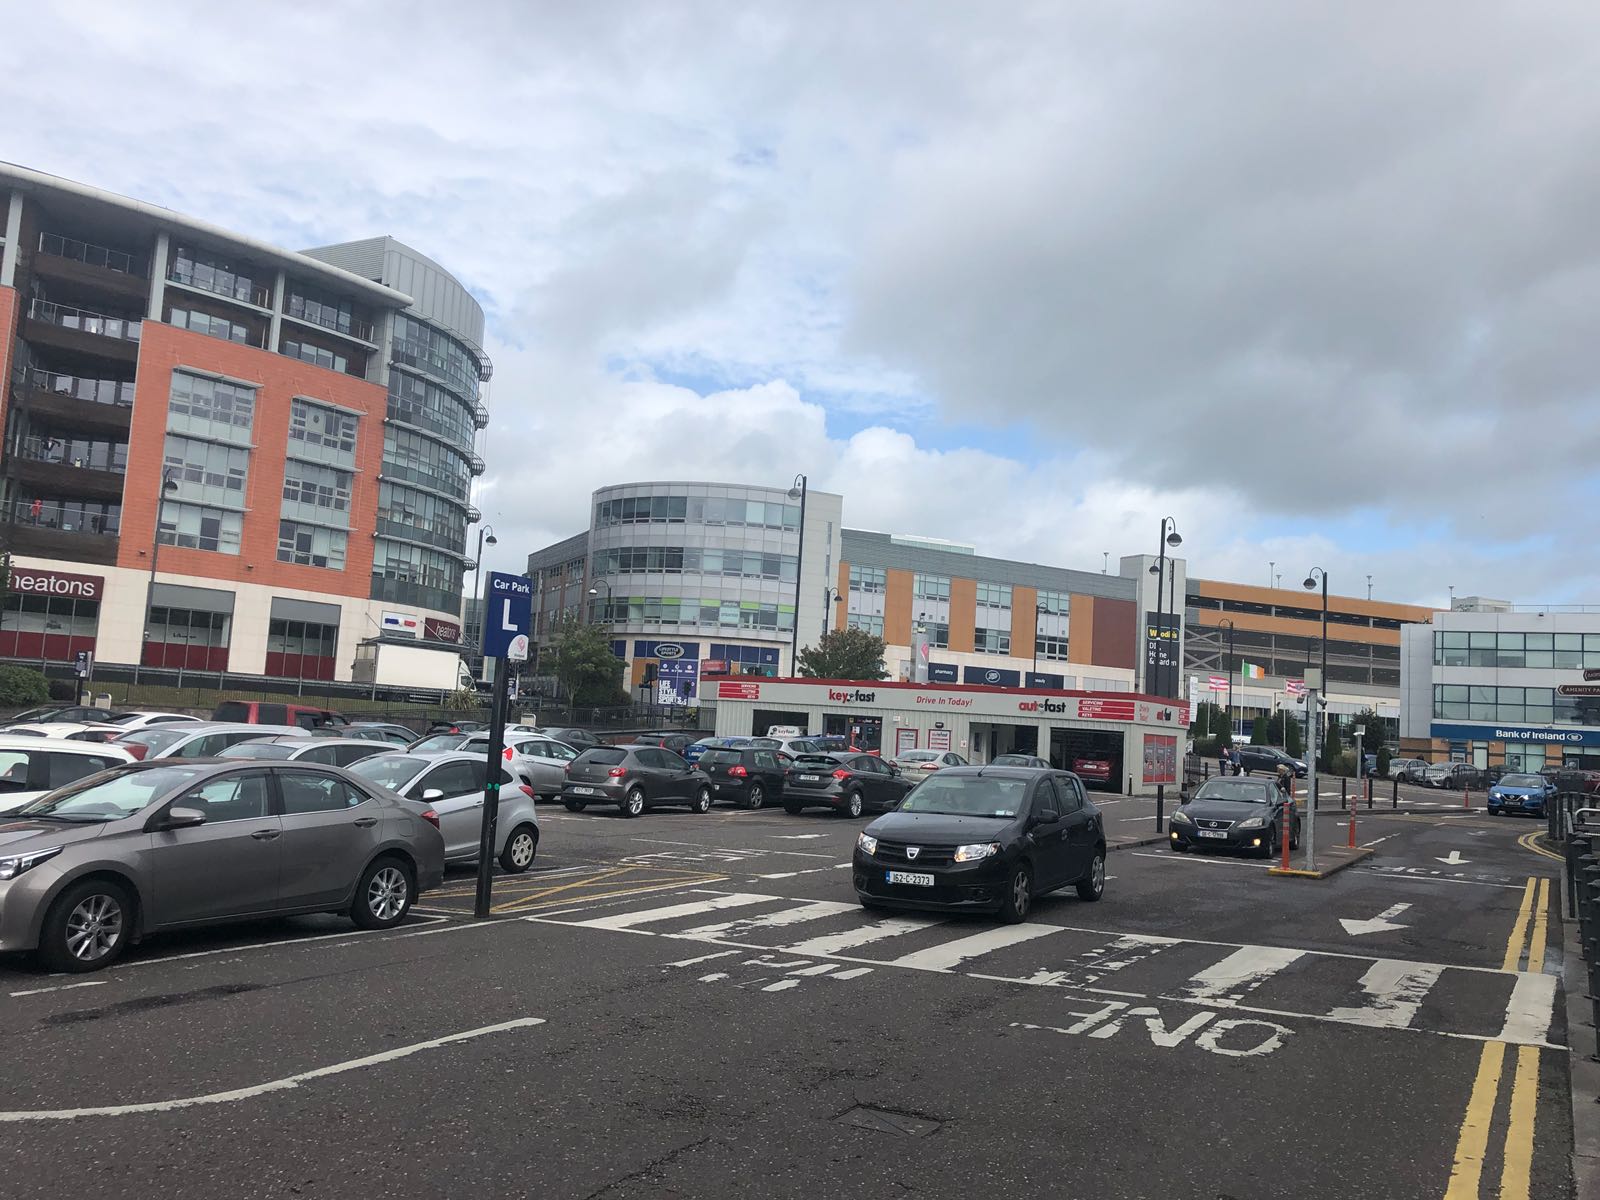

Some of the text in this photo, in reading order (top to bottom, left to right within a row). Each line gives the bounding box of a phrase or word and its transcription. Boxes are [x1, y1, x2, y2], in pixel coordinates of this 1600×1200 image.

[493, 578, 530, 594] Car Park
[502, 598, 518, 632] L
[916, 695, 973, 708] Drive In Today!
[1495, 729, 1566, 741] Bank of Ireland
